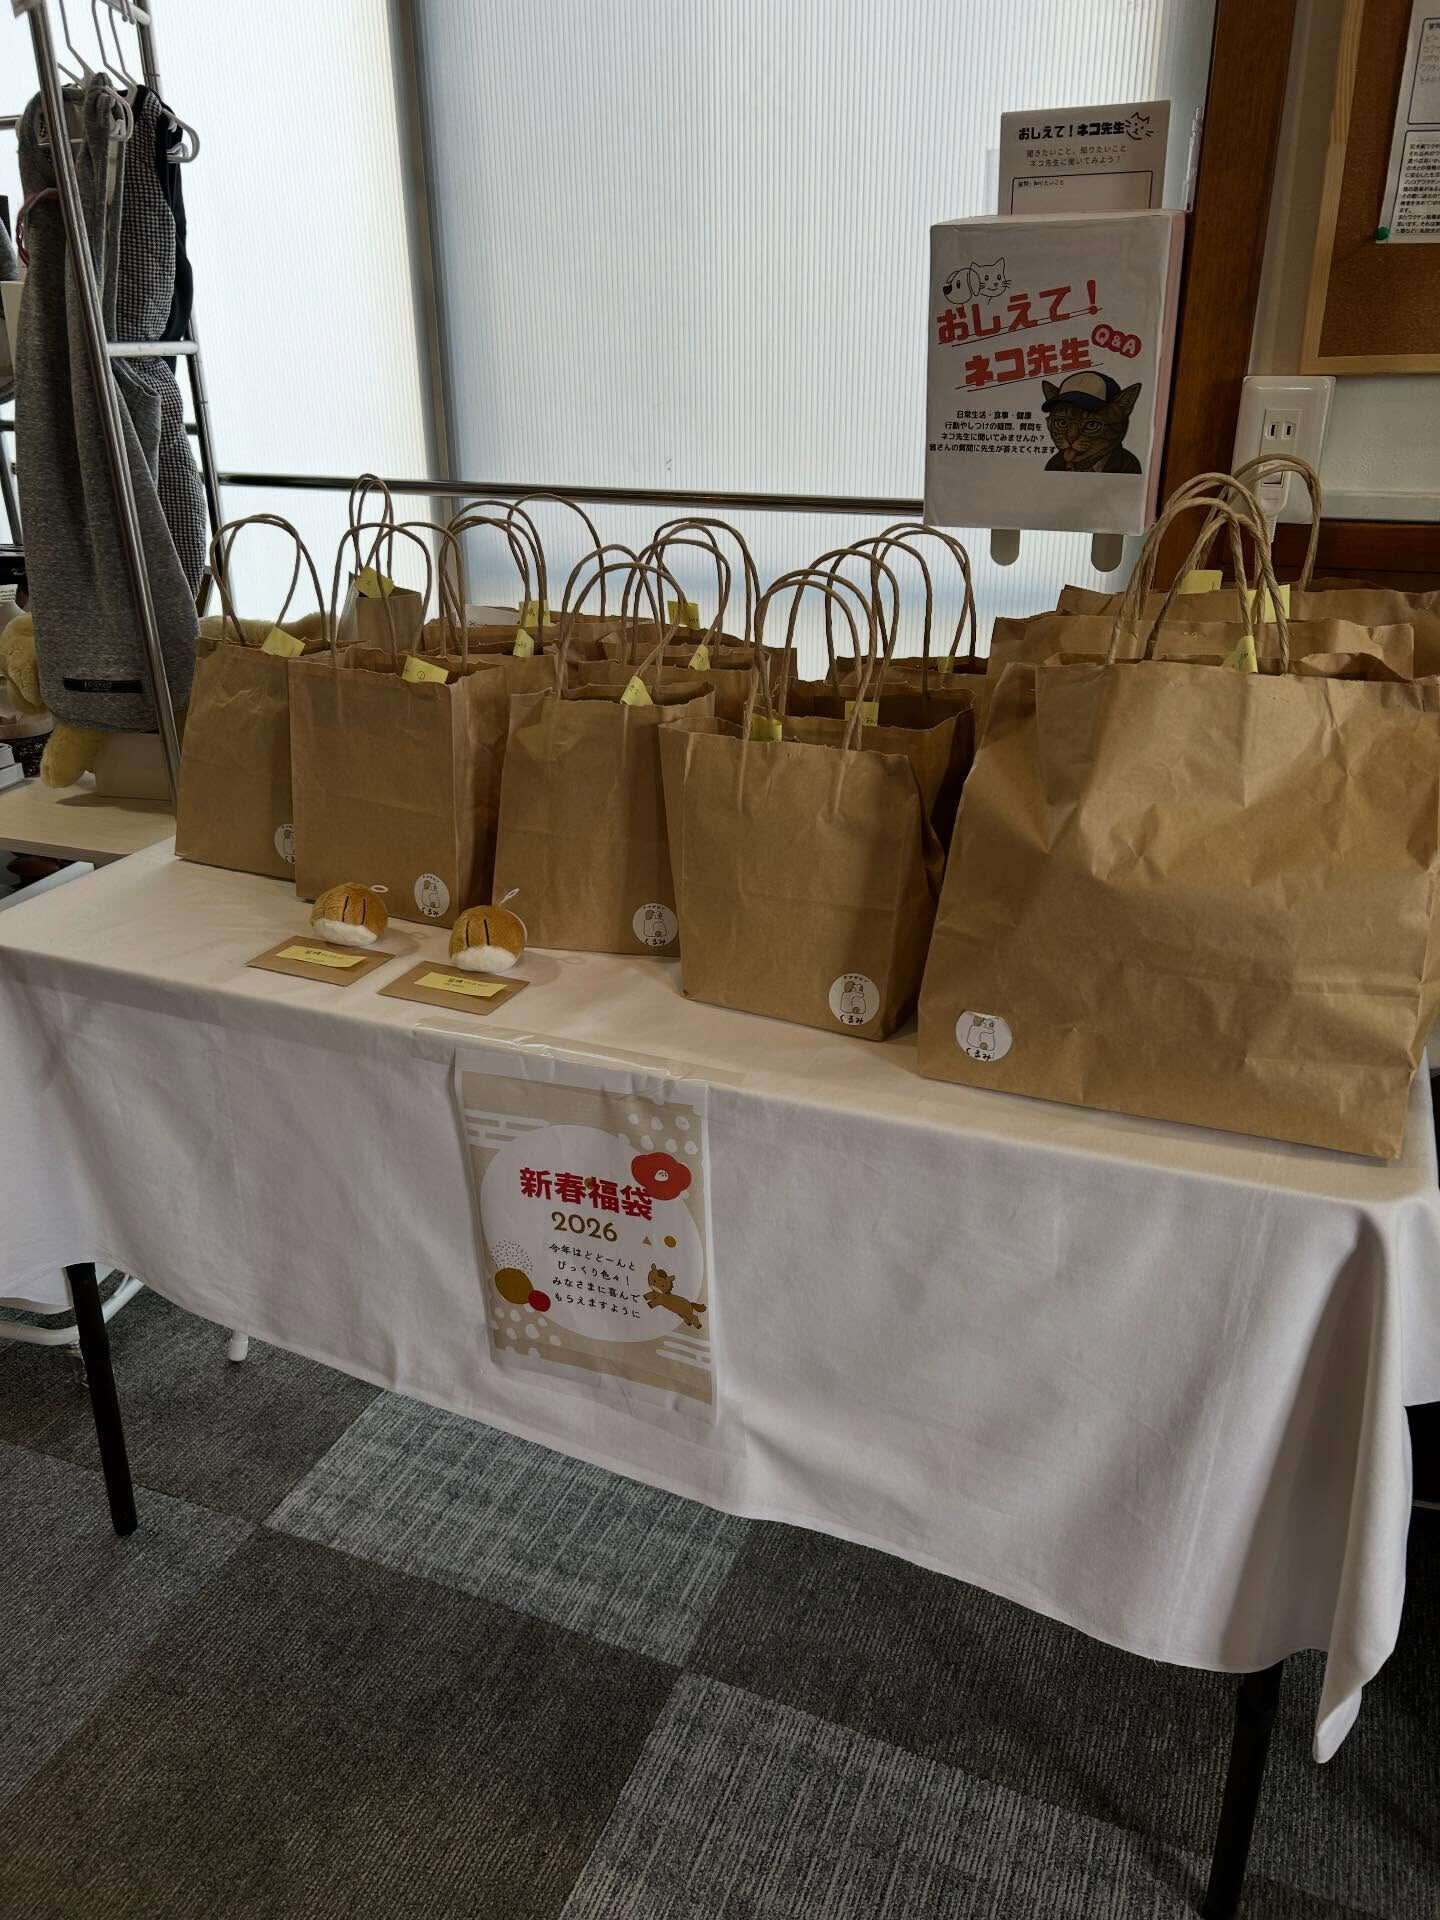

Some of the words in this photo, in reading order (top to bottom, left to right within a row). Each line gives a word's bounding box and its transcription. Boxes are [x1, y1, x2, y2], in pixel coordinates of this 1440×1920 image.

[1018, 121, 1125, 141] おしえて！ネコ先生
[937, 279, 1098, 344] おしえて！
[1093, 326, 1140, 356] Q&A
[965, 337, 1092, 387] ネコ先生
[839, 1014, 864, 1025] くるみ
[965, 1047, 992, 1061] くるみ
[519, 1167, 653, 1222] 新春福袋
[551, 1211, 618, 1243] 2026
[549, 1243, 636, 1271] 今年はどどーんと
[552, 1276, 641, 1303] みなさまに喜んで
[554, 1292, 641, 1319] もらえますように
